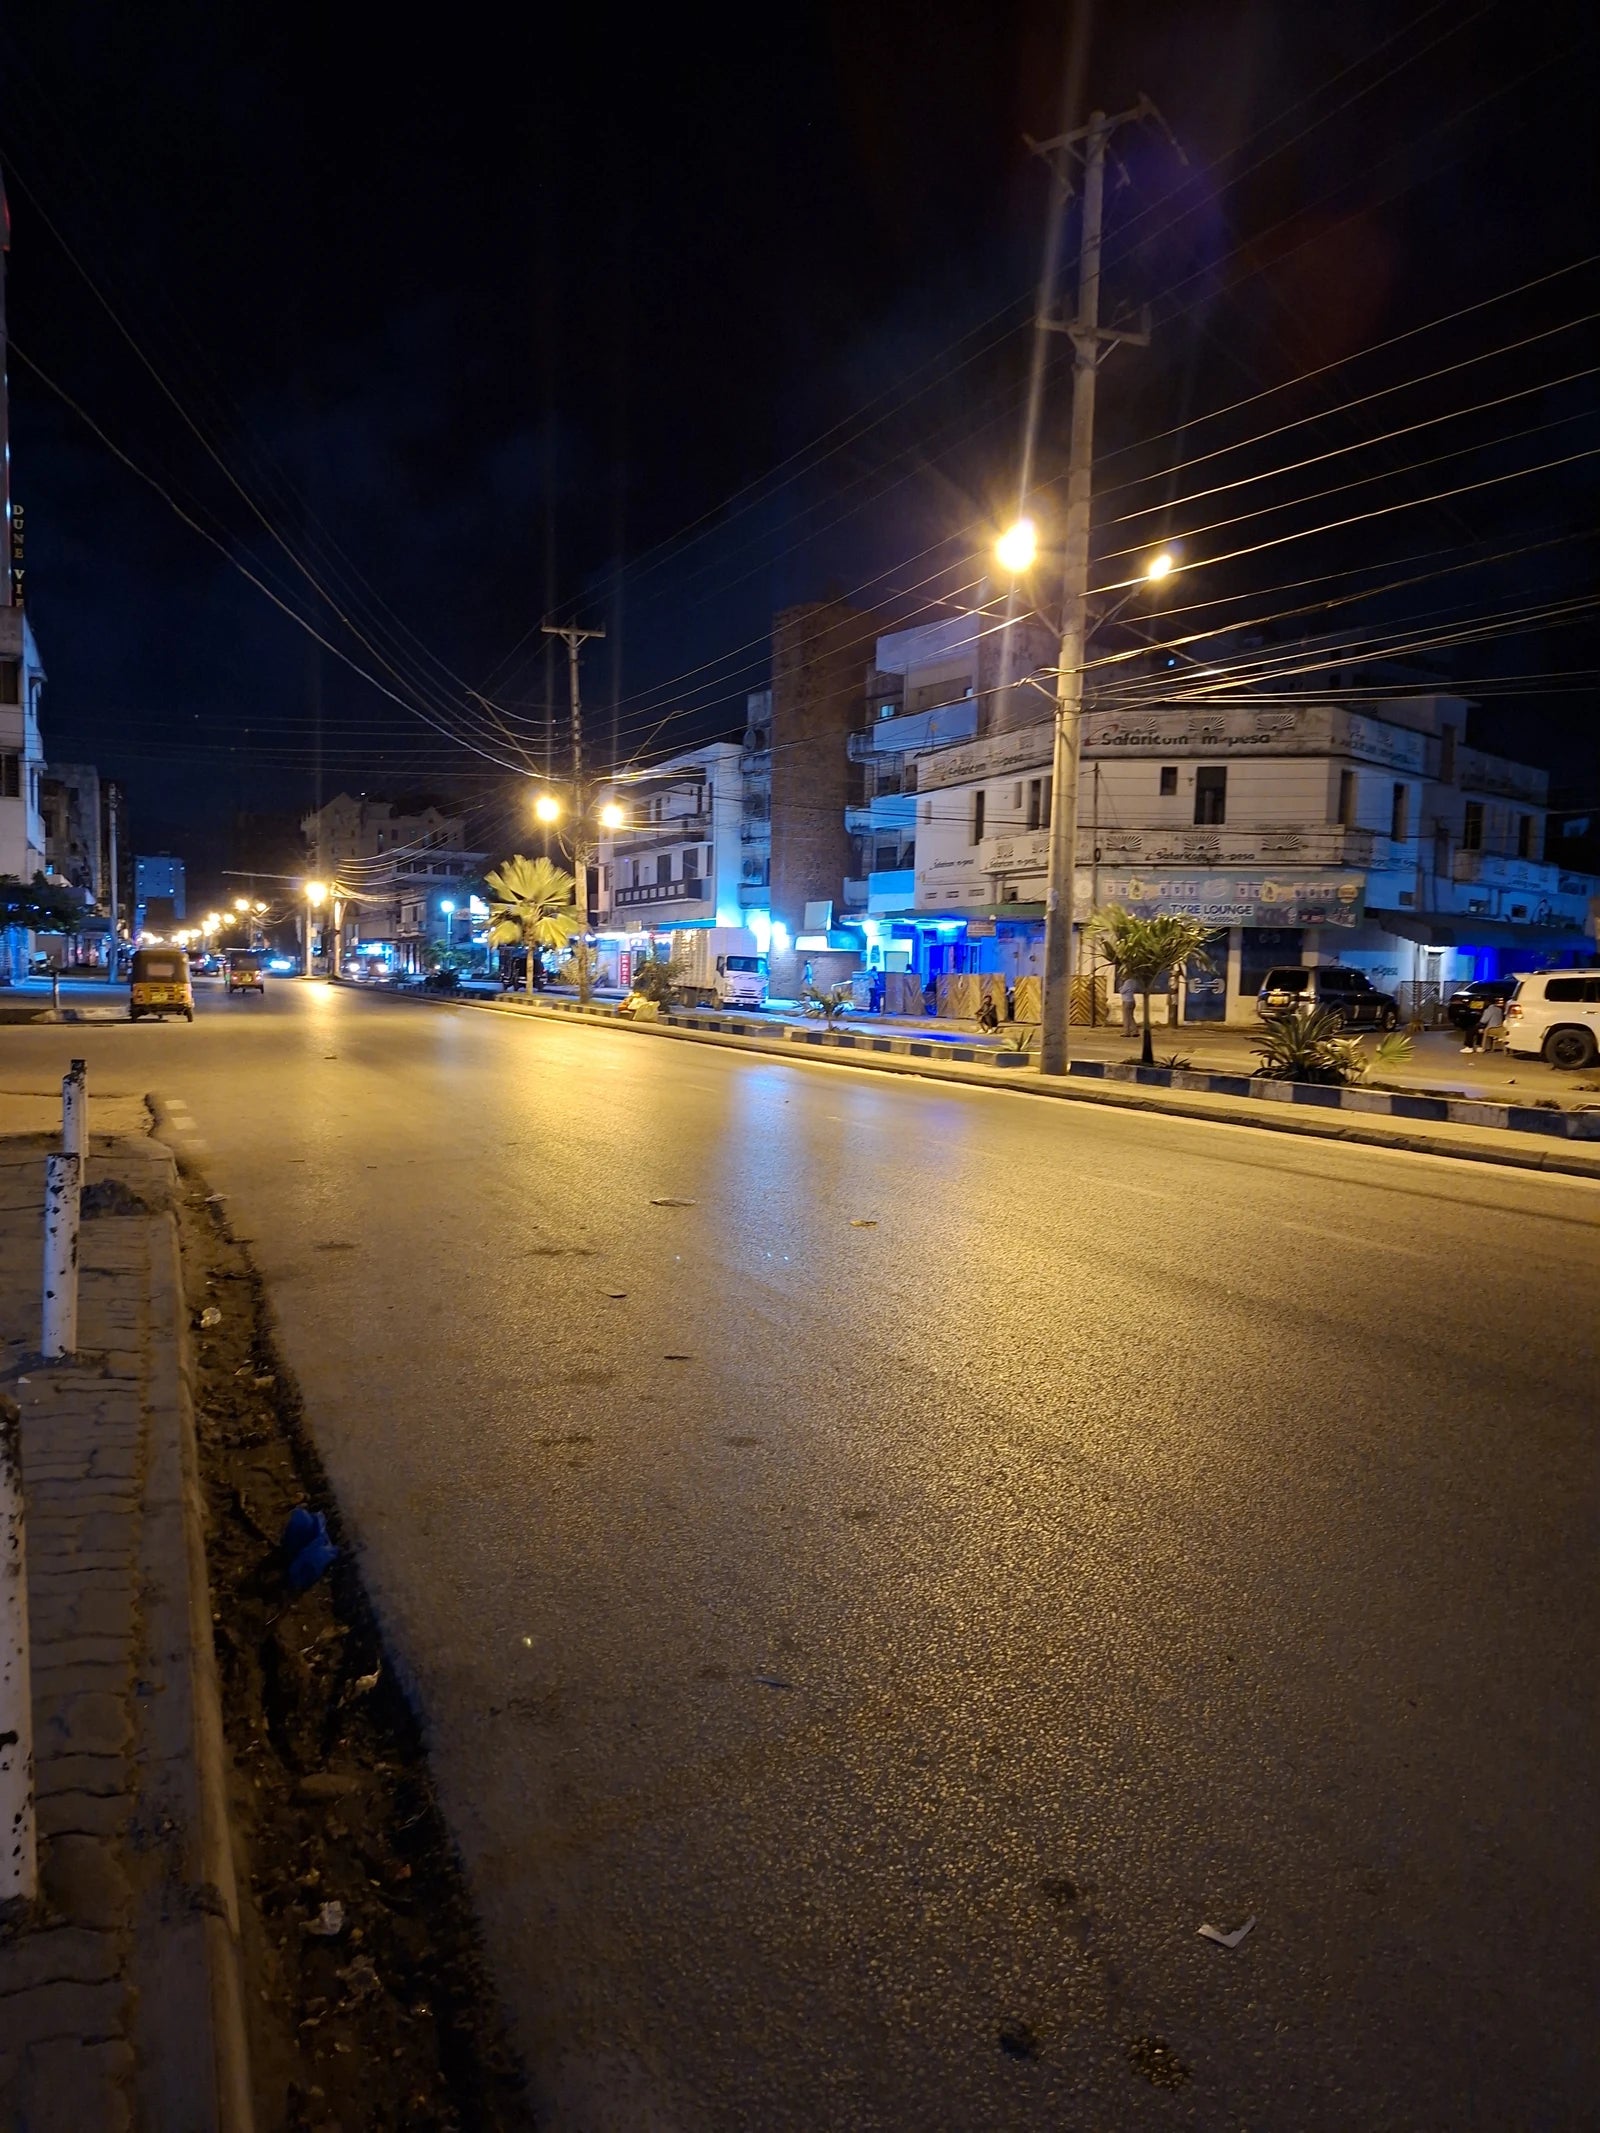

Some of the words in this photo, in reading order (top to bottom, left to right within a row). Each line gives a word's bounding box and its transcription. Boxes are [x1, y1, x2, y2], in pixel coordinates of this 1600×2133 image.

[13, 504, 25, 558] DUNE
[1101, 732, 1188, 746] Safaricom
[1157, 852, 1207, 861] Safaricom
[1170, 903, 1201, 914] TYRE
[1203, 904, 1253, 915] LOUNGE
